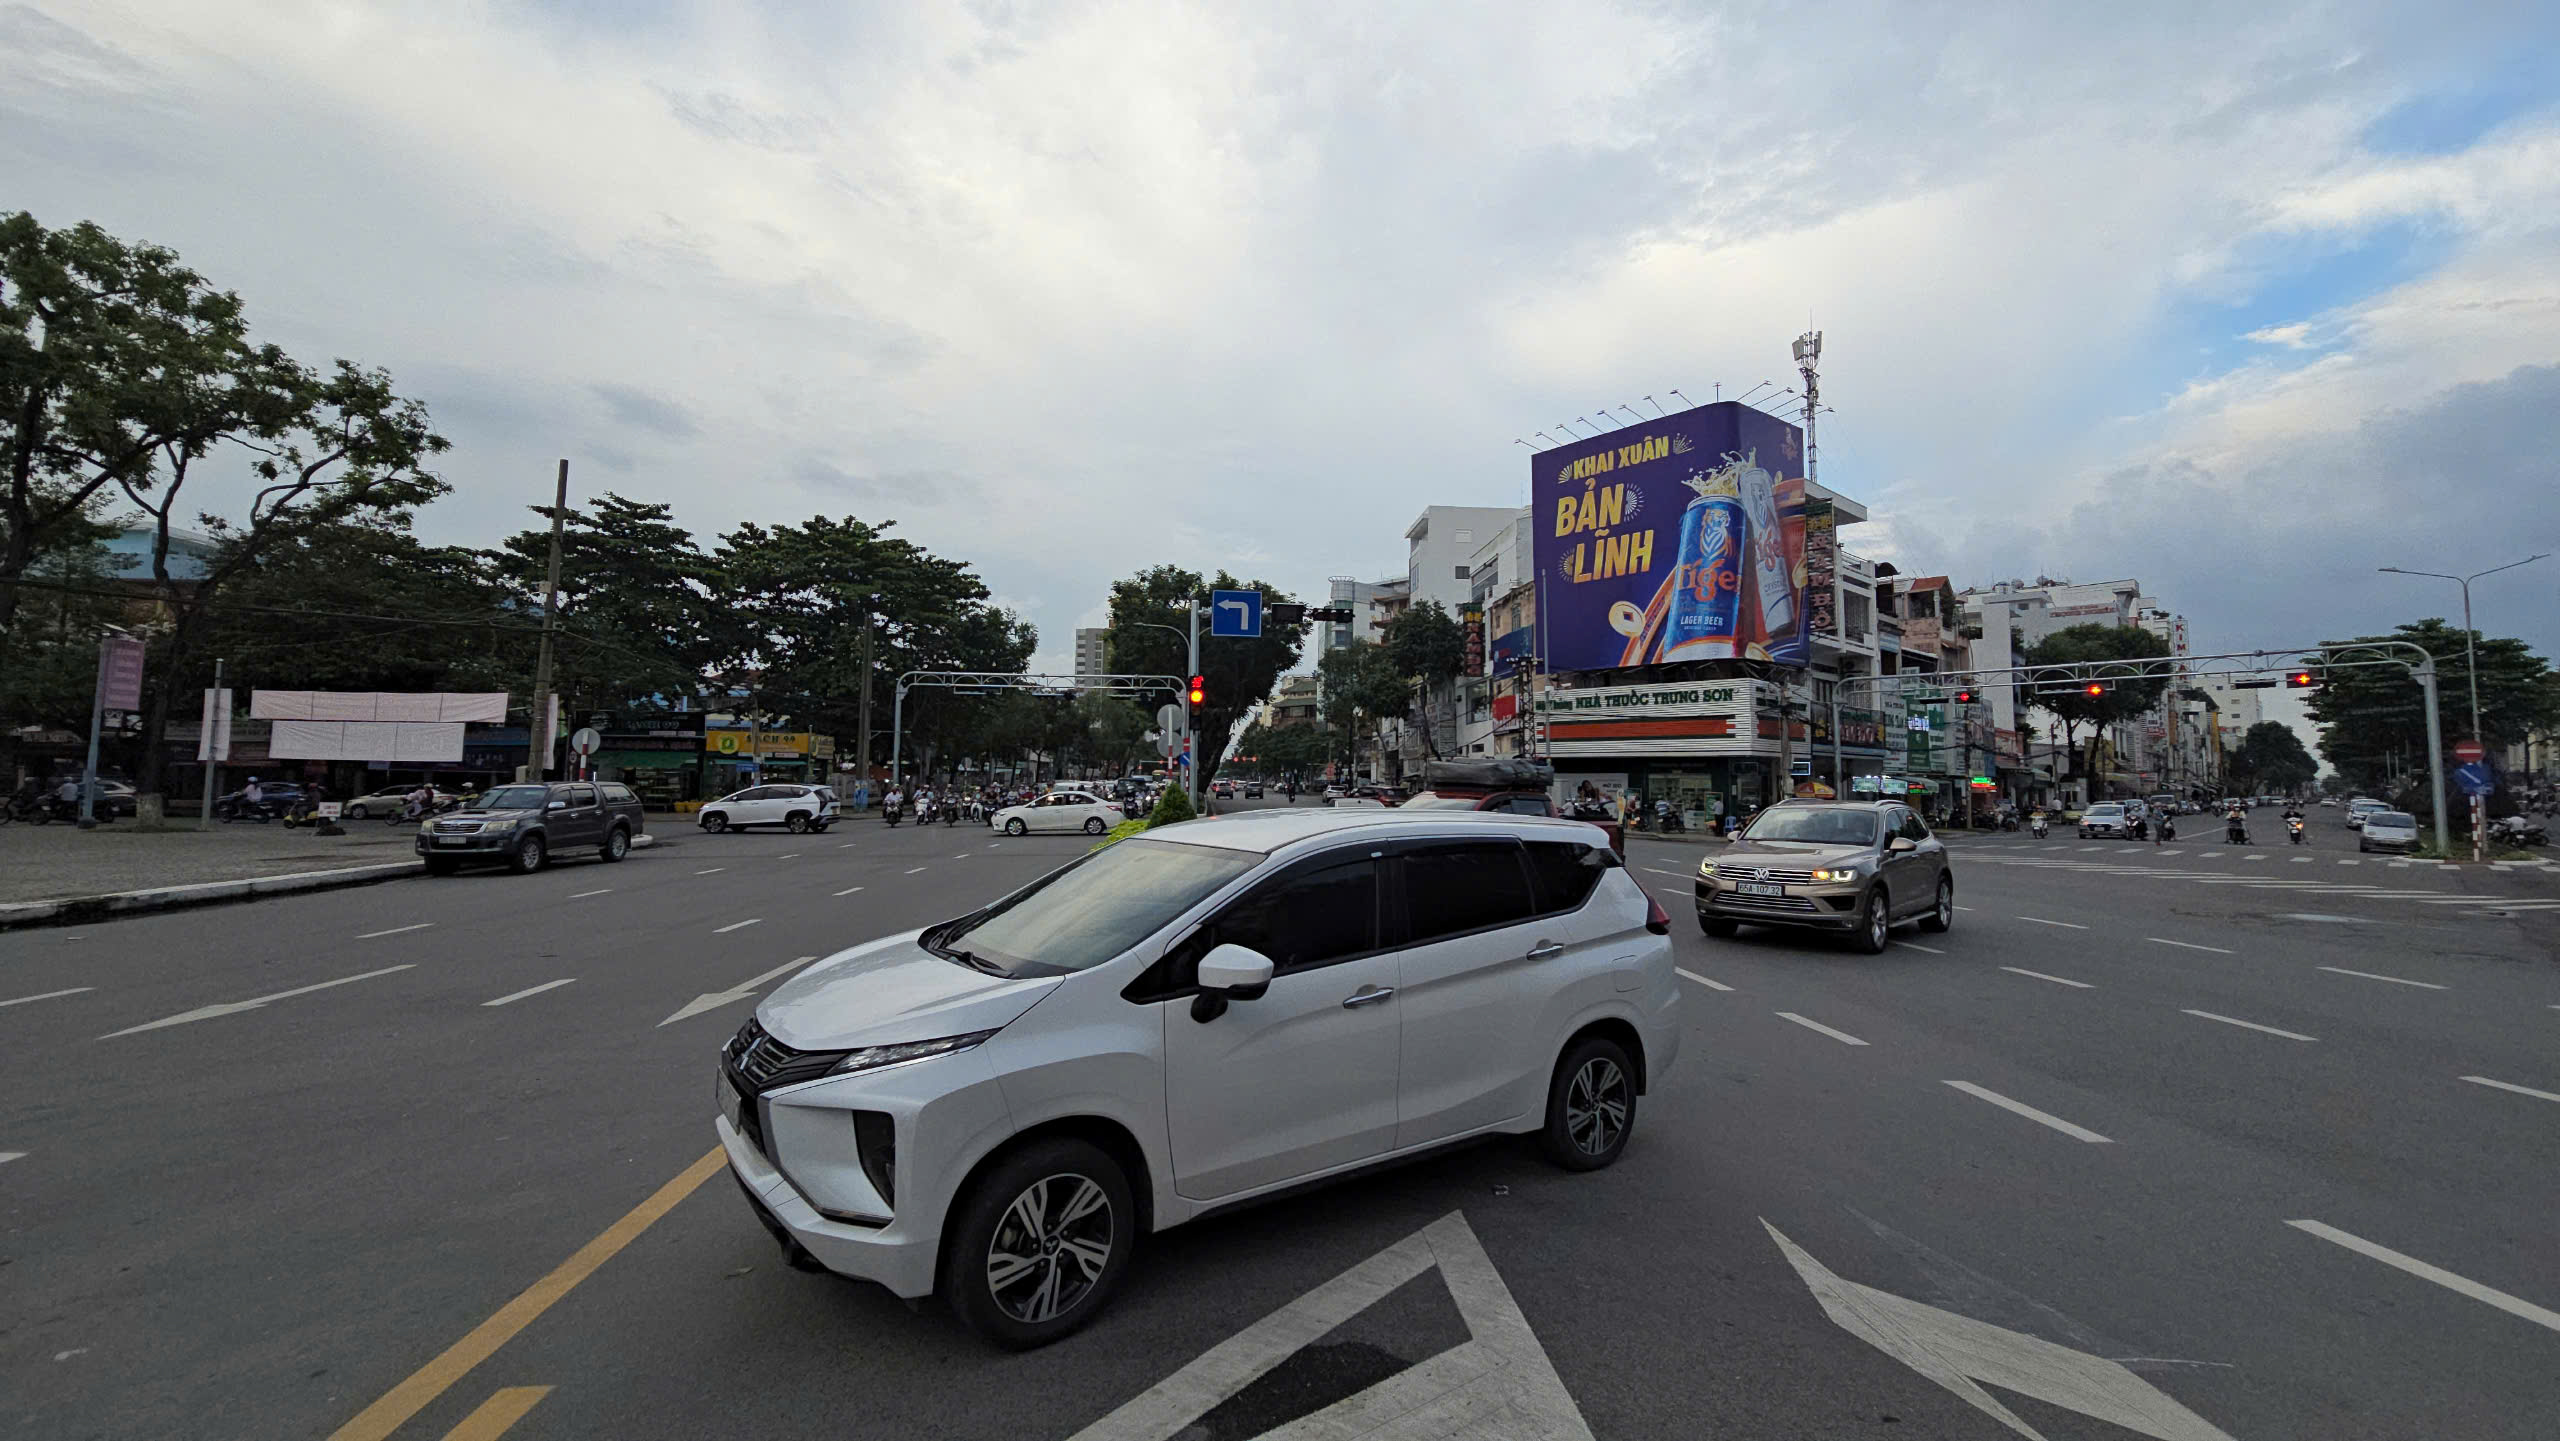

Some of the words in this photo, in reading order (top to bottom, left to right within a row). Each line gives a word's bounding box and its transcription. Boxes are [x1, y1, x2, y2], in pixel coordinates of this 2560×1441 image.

[1572, 450, 1615, 481] KHAI
[1617, 434, 1670, 467] XUÂN
[1555, 477, 1625, 538] BẢN
[1572, 528, 1655, 584] LĨNH
[1680, 615, 1703, 626] LAGER
[1703, 616, 1724, 628] BEER
[2175, 624, 2187, 651] KIM
[1576, 692, 1602, 709] NHÀ
[1603, 689, 1649, 707] THUỐC
[1653, 691, 1700, 704] TRUNG
[745, 734, 780, 744] SCH
